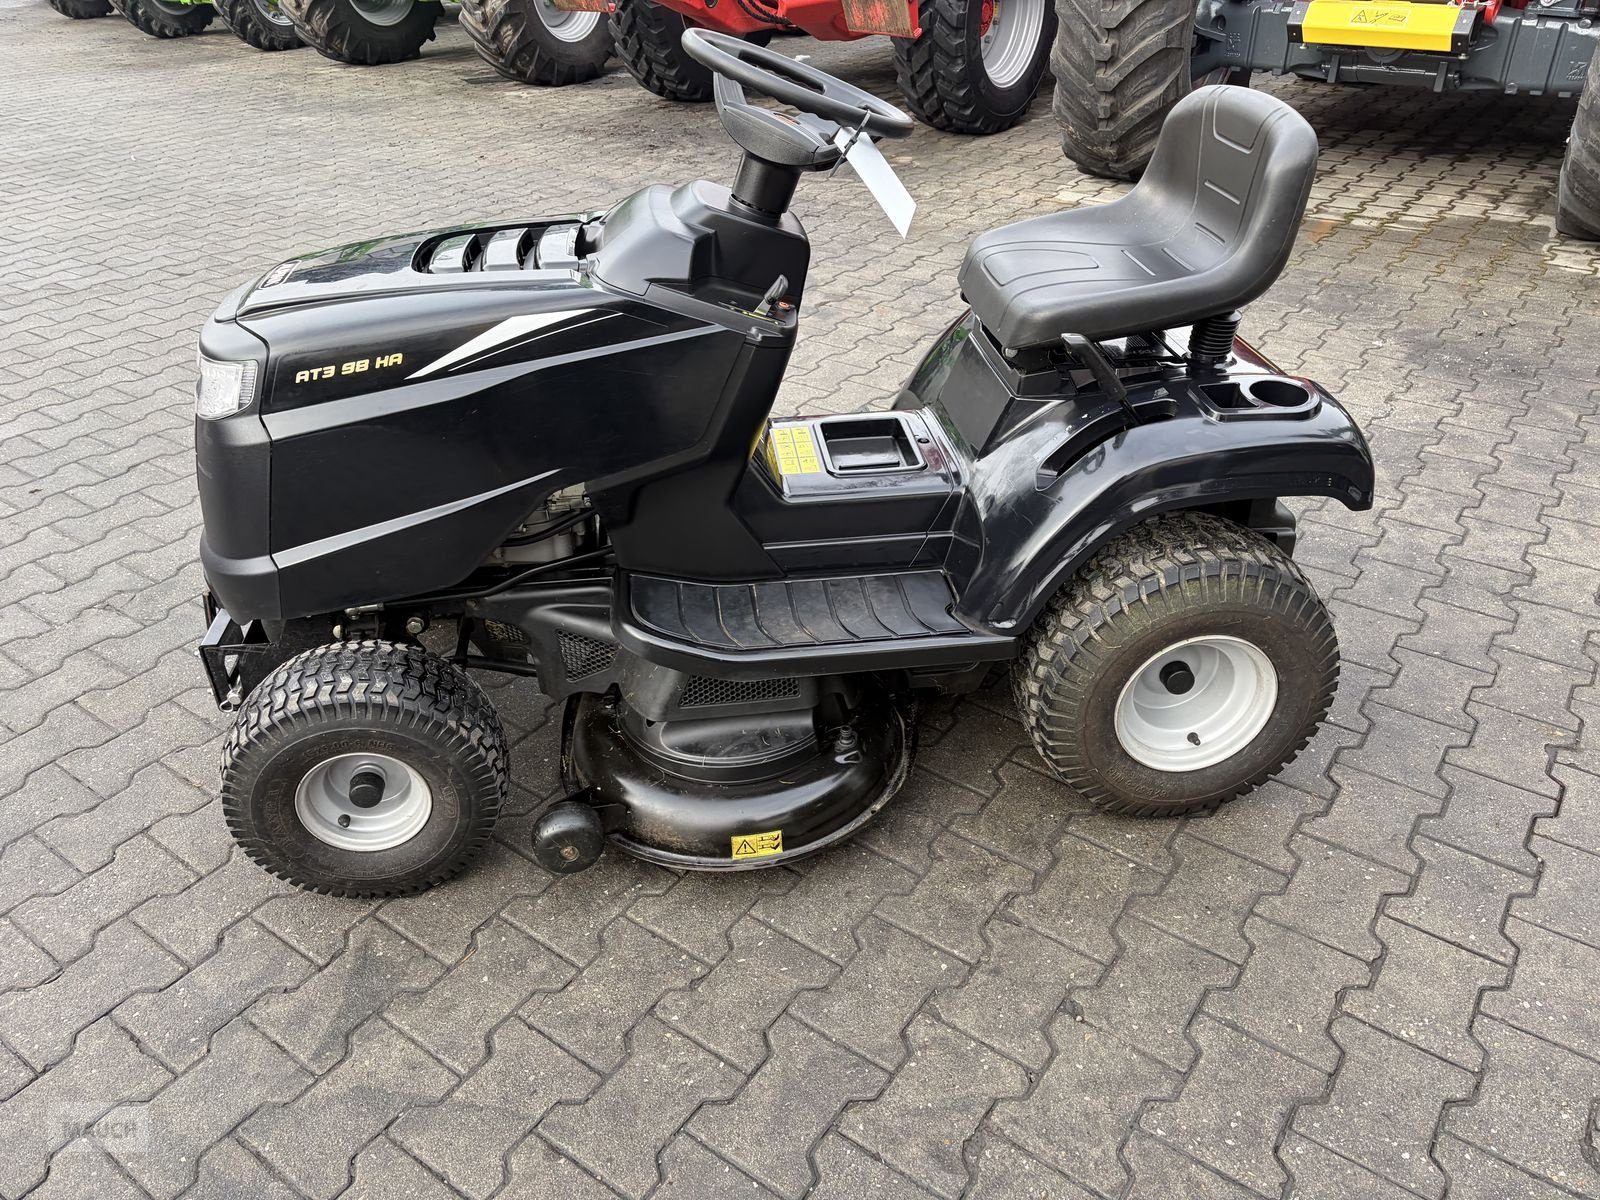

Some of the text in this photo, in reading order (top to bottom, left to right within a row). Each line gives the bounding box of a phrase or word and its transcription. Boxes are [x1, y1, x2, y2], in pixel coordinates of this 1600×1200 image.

[295, 352, 404, 384] AT3 98 HA
